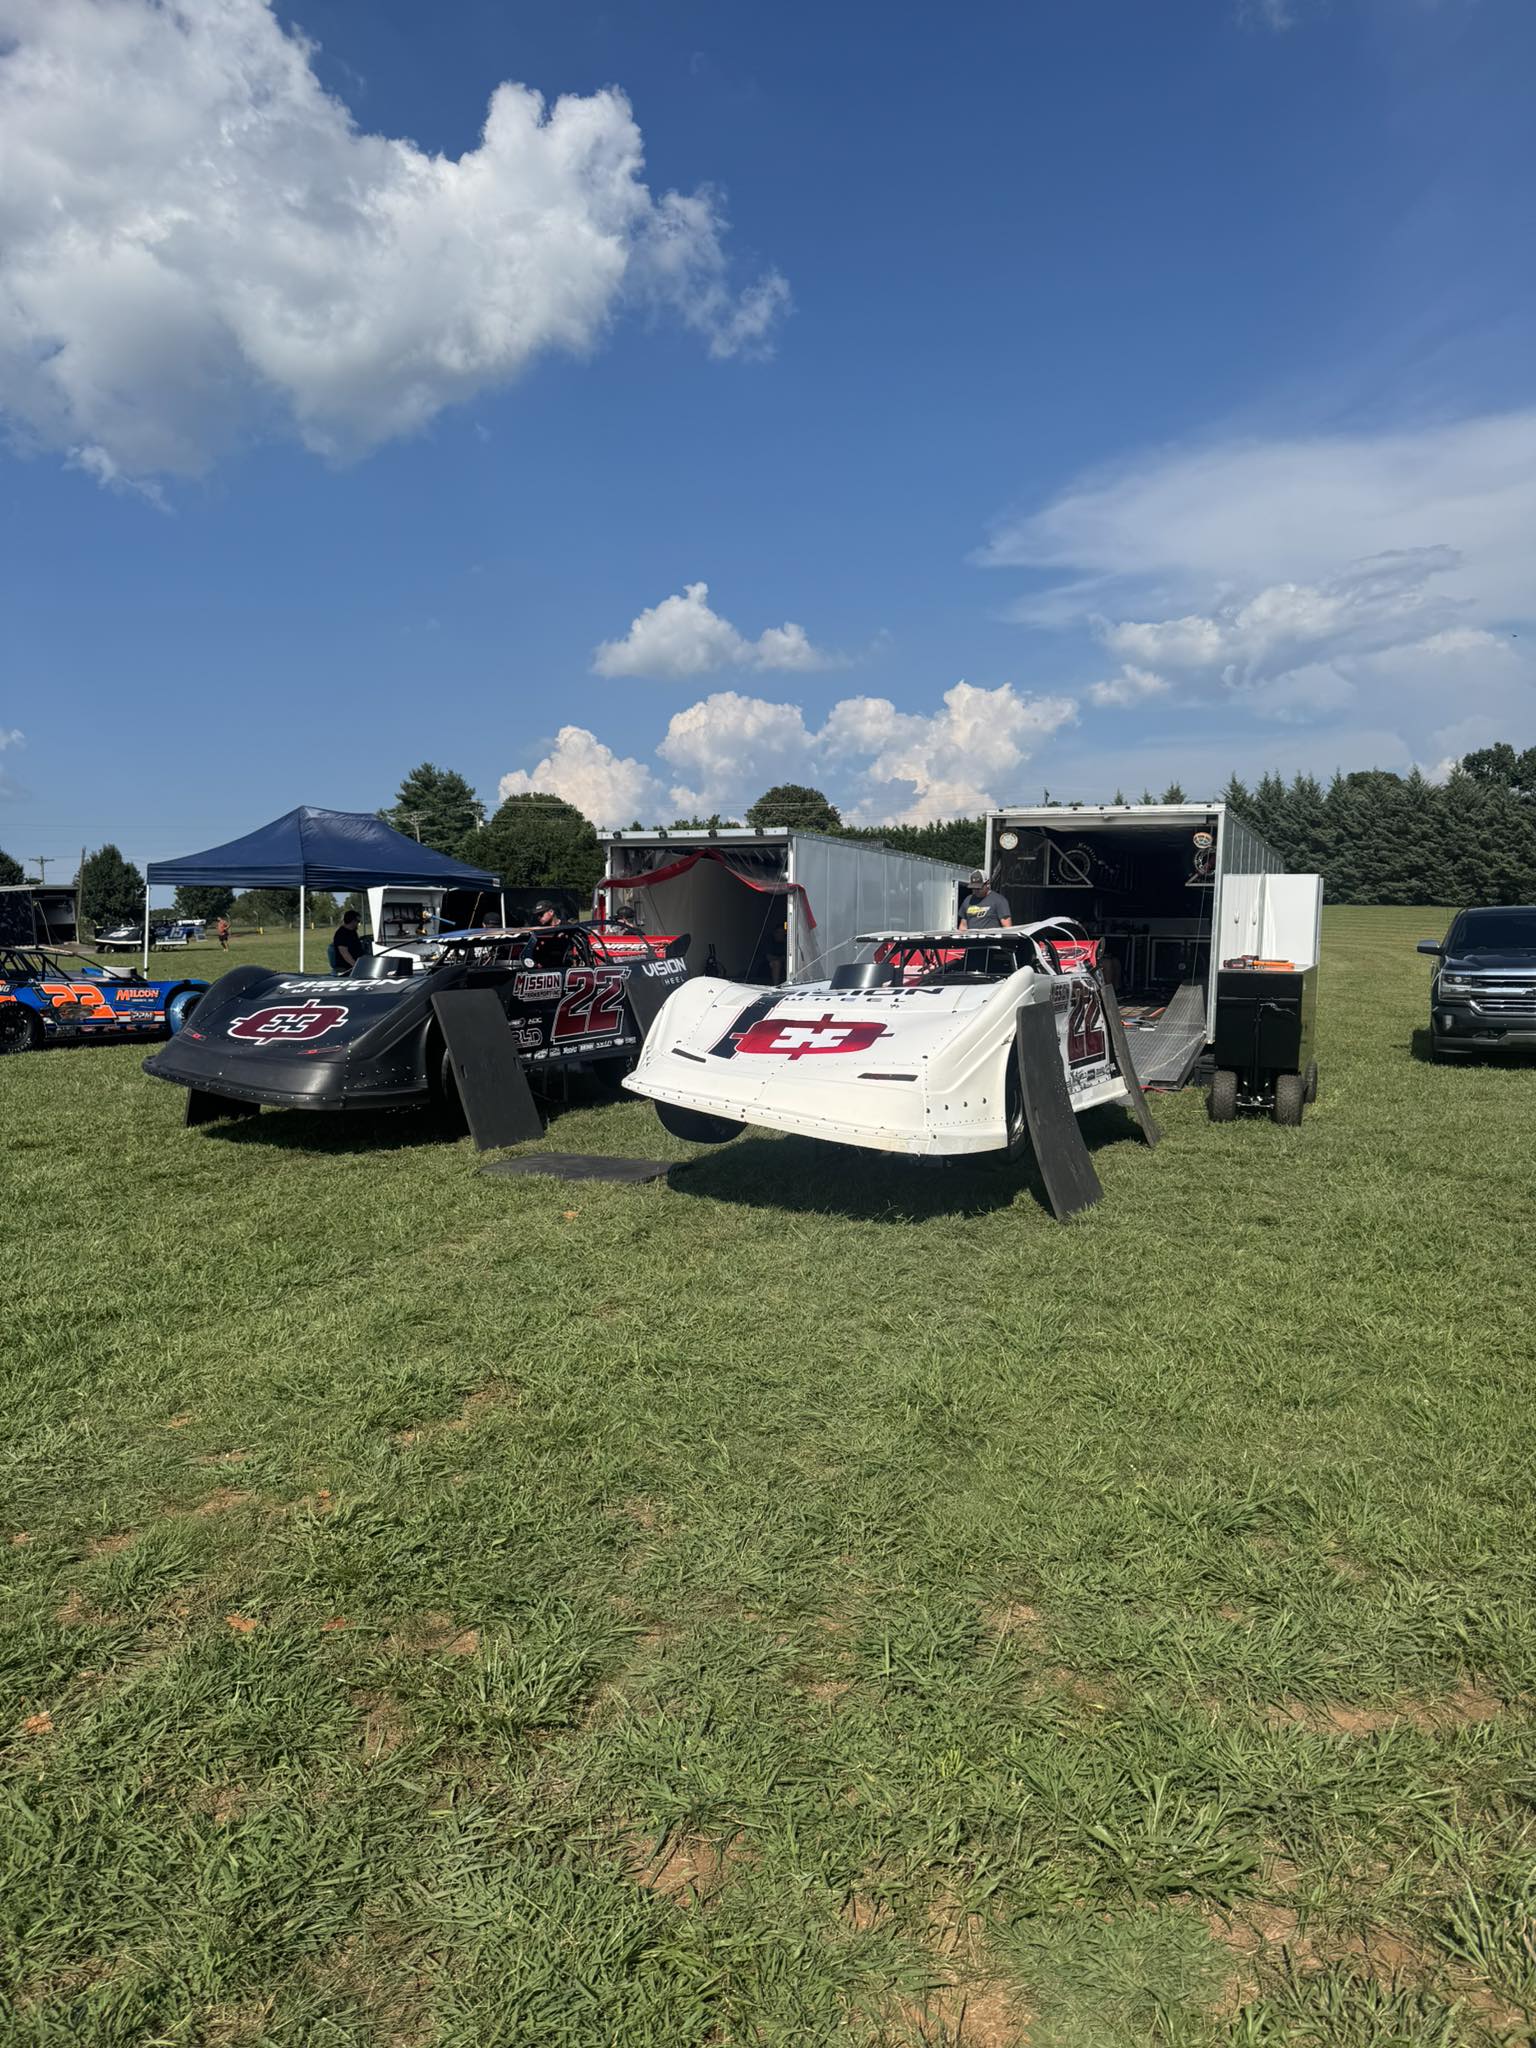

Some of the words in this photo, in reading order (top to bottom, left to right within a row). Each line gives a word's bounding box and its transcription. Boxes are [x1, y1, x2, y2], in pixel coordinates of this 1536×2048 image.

[641, 957, 687, 977] VISION
[280, 978, 408, 989] VISION
[514, 973, 561, 996] MISSION
[664, 976, 685, 985] HEEL
[116, 989, 159, 1001] MILCON
[551, 966, 631, 1045] 22
